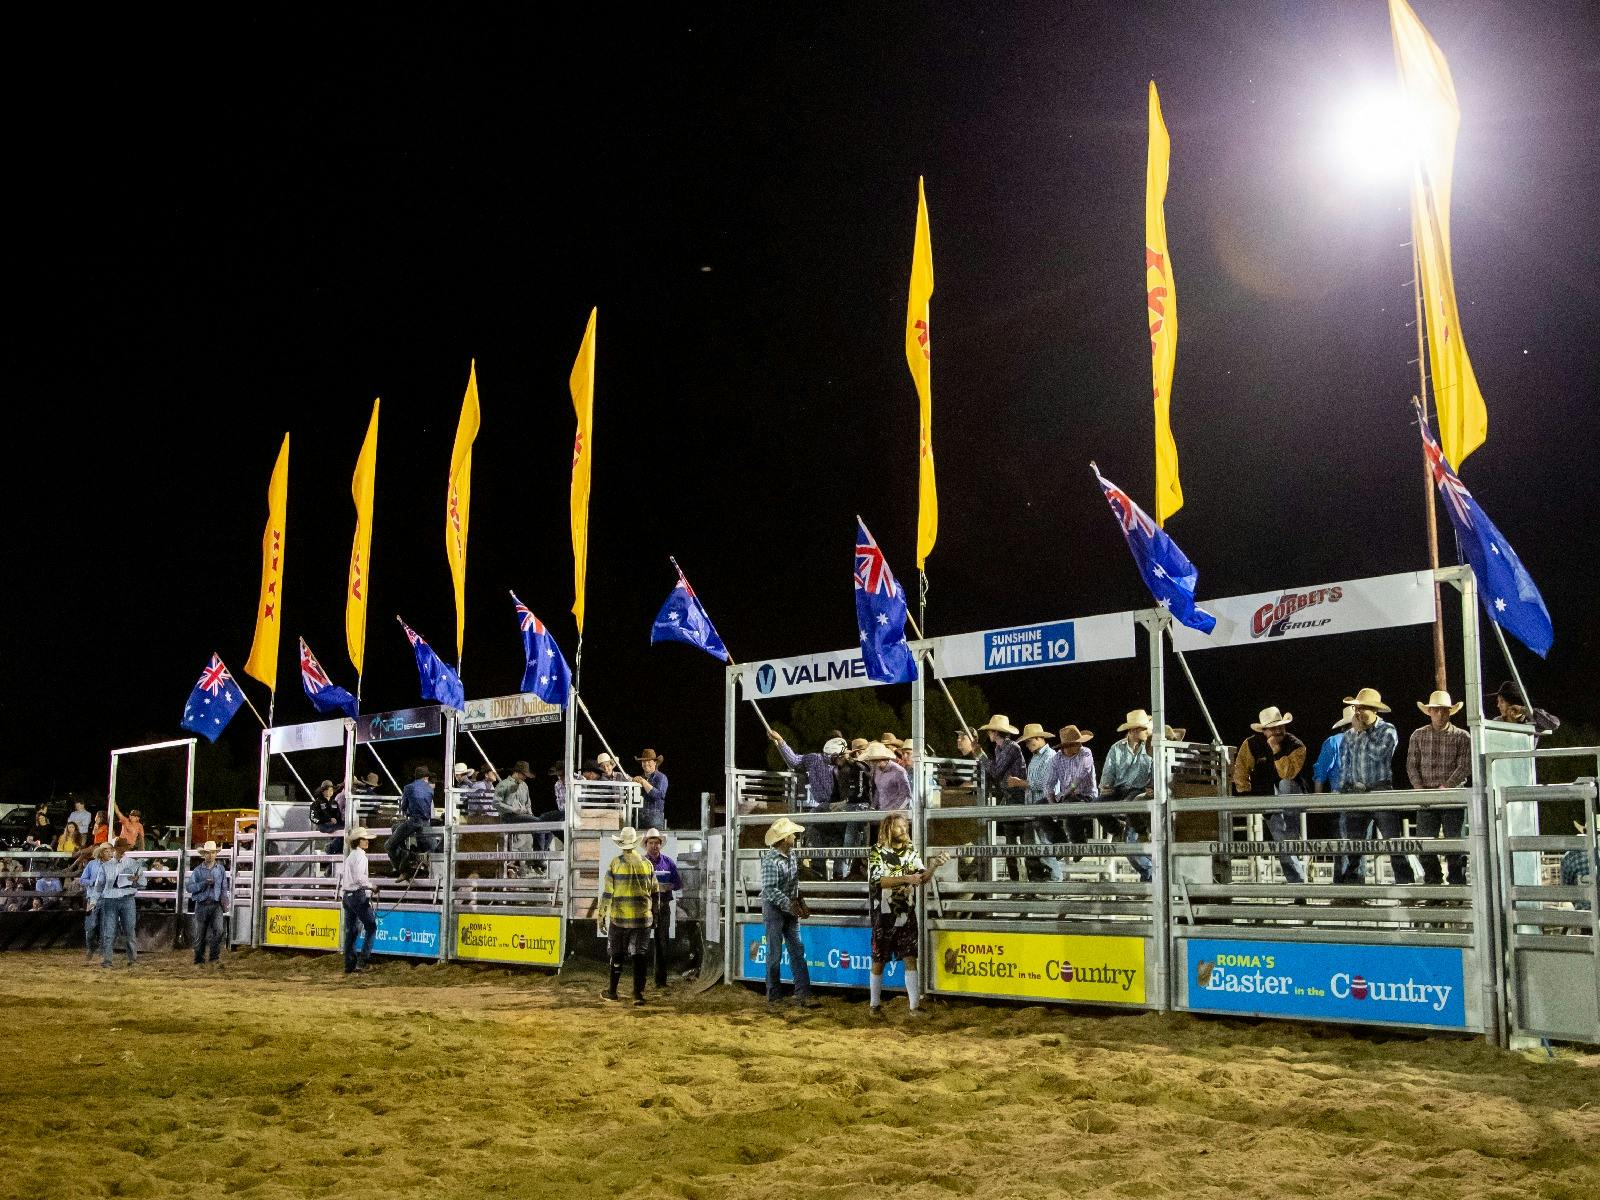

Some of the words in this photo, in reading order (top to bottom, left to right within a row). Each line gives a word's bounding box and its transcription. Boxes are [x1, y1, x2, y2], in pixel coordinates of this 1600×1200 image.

[1250, 586, 1343, 638] CORBET'S
[1281, 618, 1332, 632] GROUP
[992, 629, 1042, 646] SUNSHINE
[988, 641, 1043, 667] MITRE
[1047, 638, 1070, 660] 10
[782, 657, 866, 686] VALME
[1052, 843, 1118, 857] FABRICATION
[1209, 841, 1265, 854] CLIFFORD
[1268, 840, 1325, 854] WELDING
[1338, 839, 1425, 854] FABRICATION
[469, 923, 492, 932] ROMA'S
[463, 930, 498, 948] Easter
[511, 933, 556, 955] Country
[960, 943, 1005, 956] ROMA'S
[1216, 954, 1275, 969] ROMA'S
[951, 954, 1018, 979] Easter
[1018, 971, 1027, 980] in
[1028, 971, 1042, 981] the
[1045, 959, 1137, 992] Country
[1206, 967, 1293, 996] Easter
[1294, 986, 1305, 996] in
[1307, 986, 1326, 998] the
[1330, 972, 1453, 1012] Country
